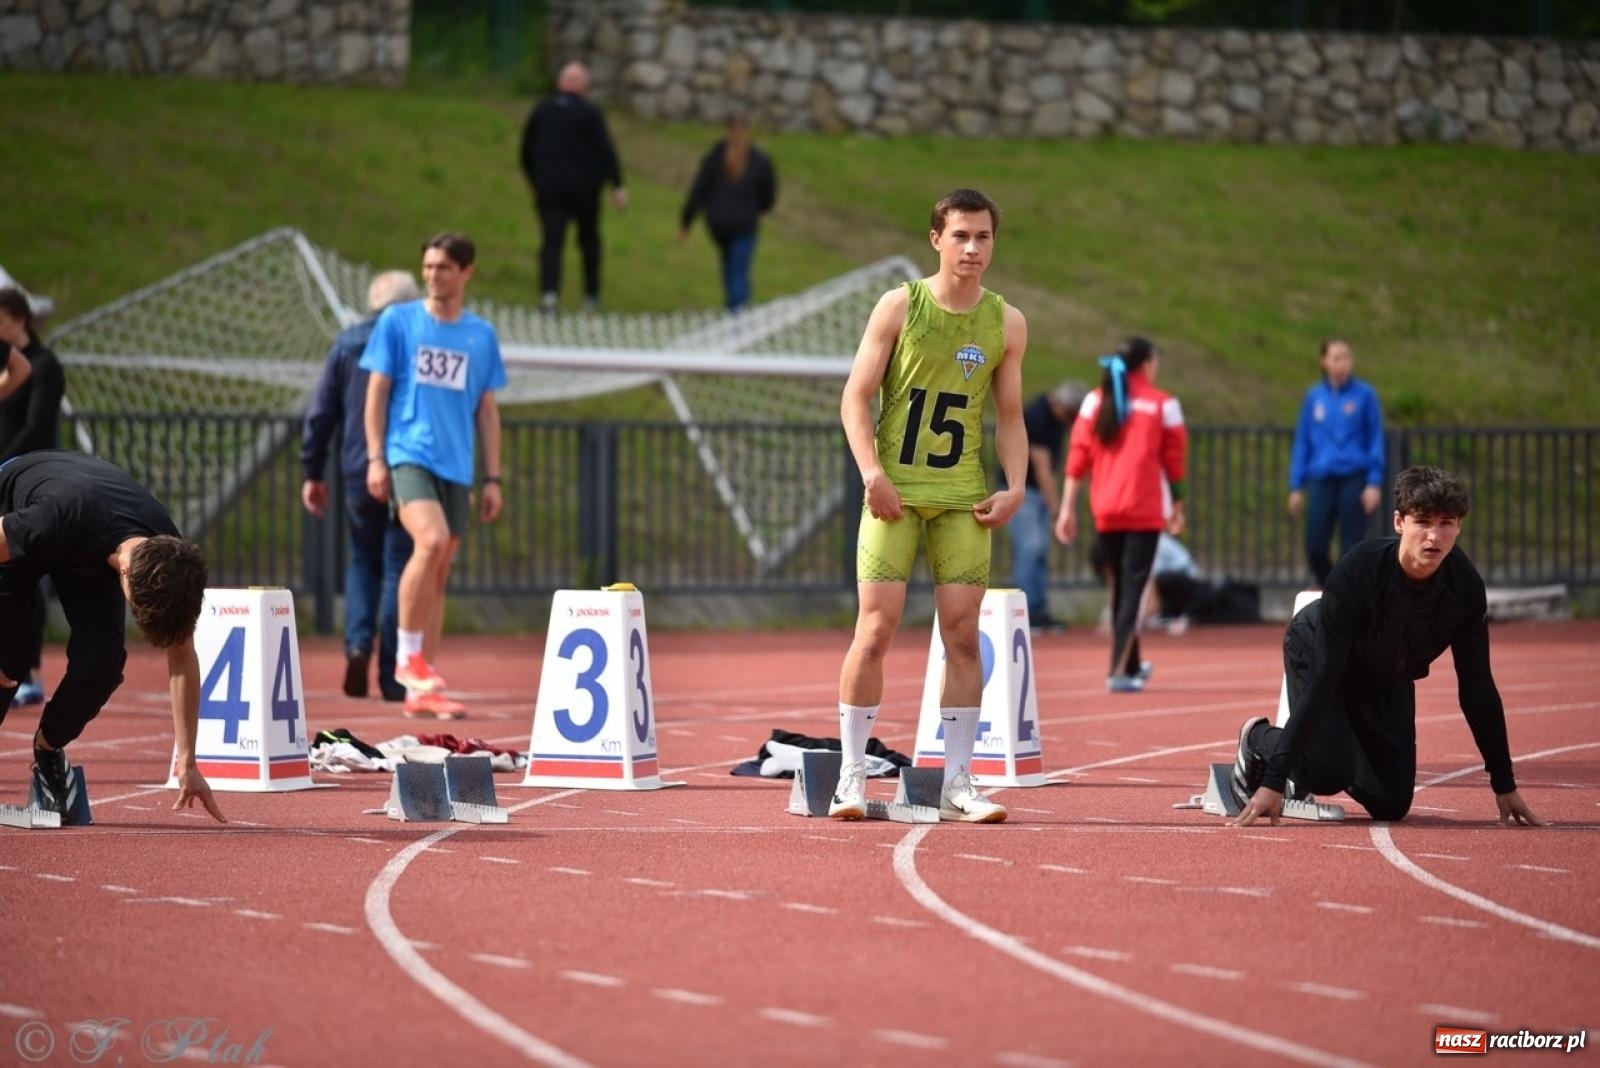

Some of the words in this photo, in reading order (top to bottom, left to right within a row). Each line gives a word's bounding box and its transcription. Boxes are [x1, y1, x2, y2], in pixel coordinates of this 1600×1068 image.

[418, 350, 464, 381] 337
[956, 352, 986, 364] MKS
[899, 388, 969, 469] 15
[199, 627, 250, 744] 4
[271, 627, 299, 744] 4
[553, 628, 609, 743] 3
[630, 628, 649, 743] 3
[1012, 628, 1034, 742] 2
[239, 737, 259, 750] Km
[600, 738, 622, 752] Km
